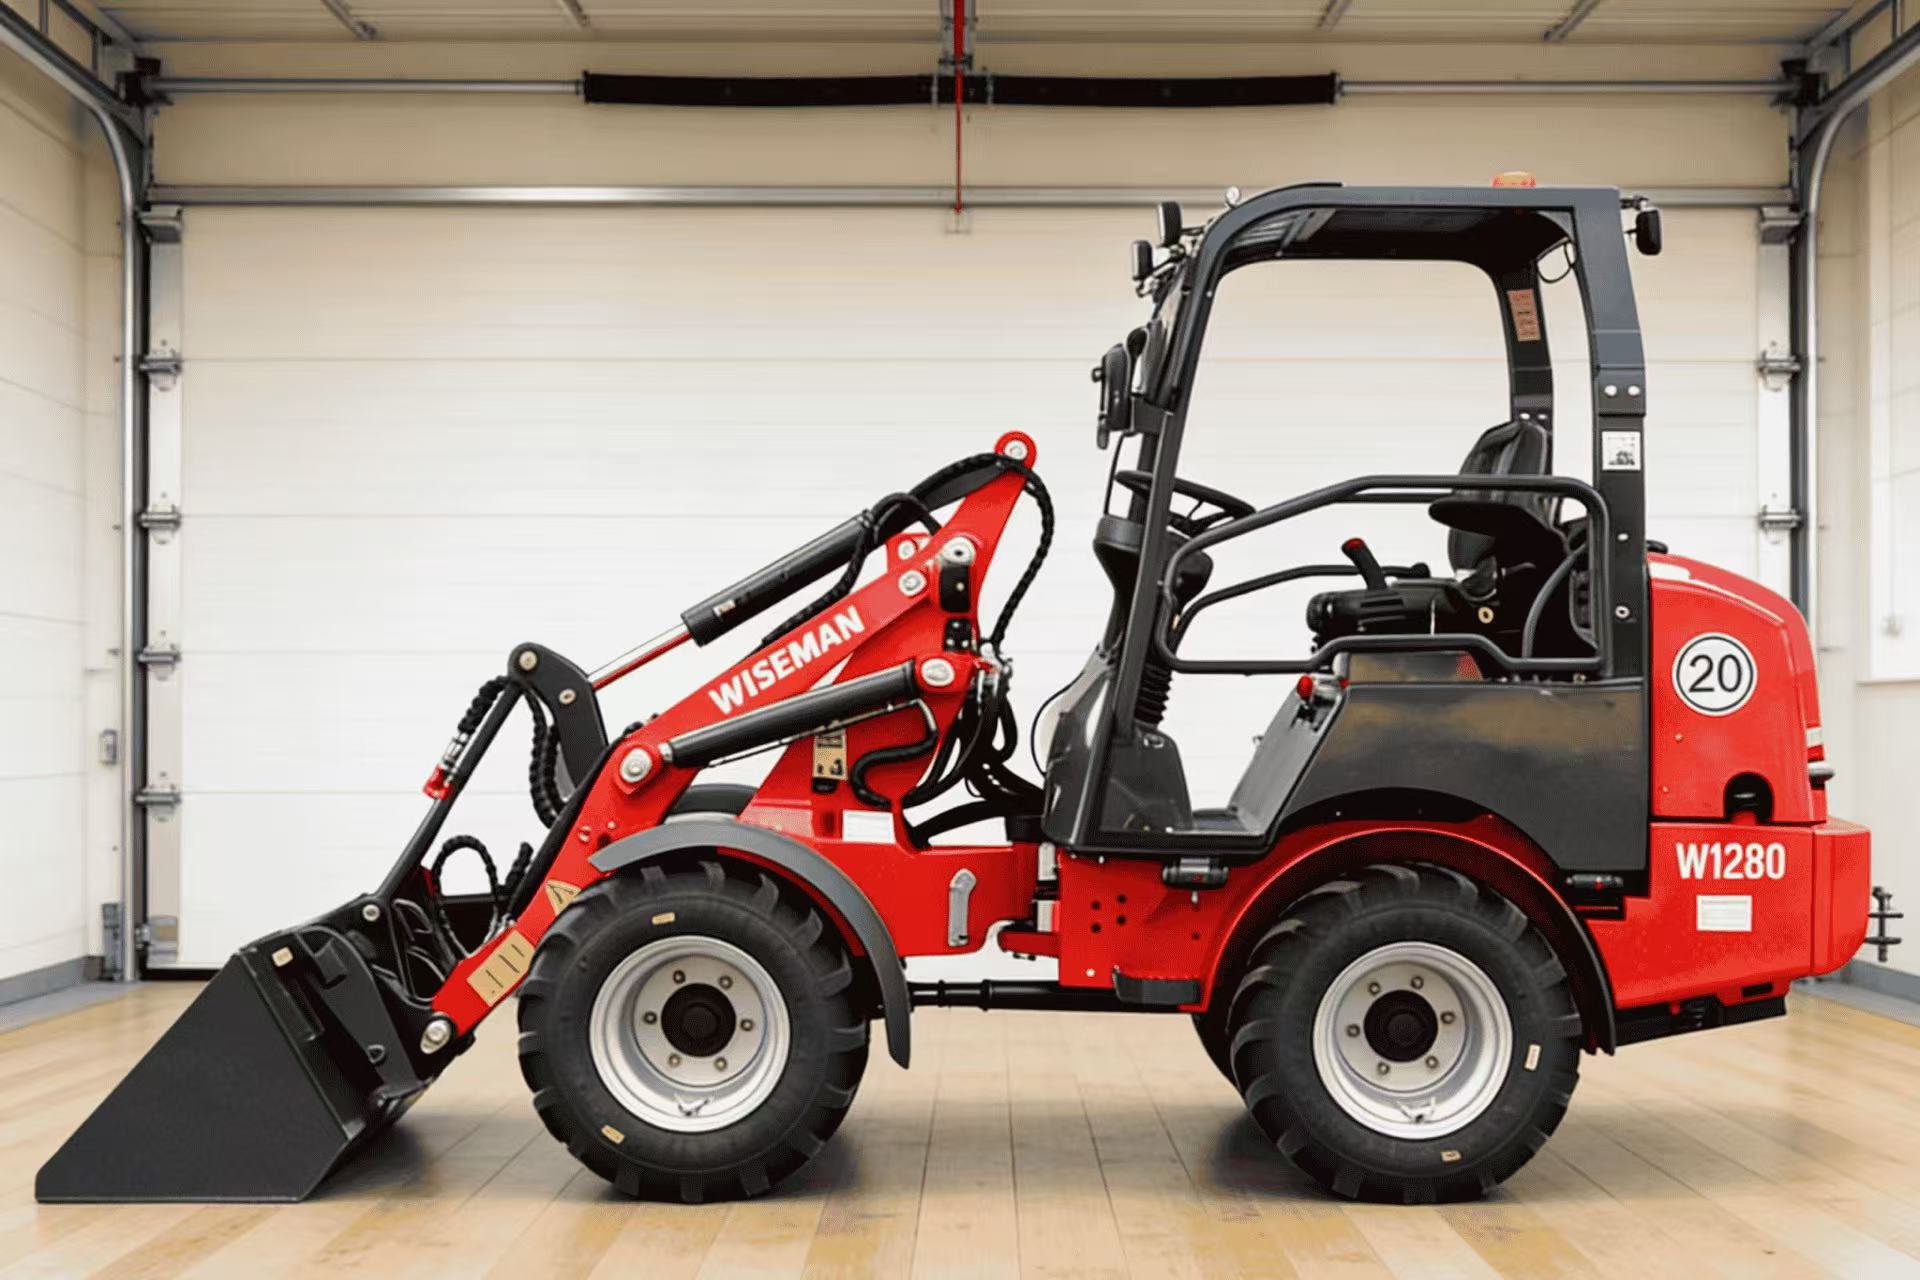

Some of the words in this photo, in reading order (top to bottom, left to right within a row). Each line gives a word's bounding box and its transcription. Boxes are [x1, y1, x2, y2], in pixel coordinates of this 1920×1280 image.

[708, 605, 865, 715] WISEMAN
[1688, 654, 1742, 693] 20
[1676, 842, 1786, 880] W1280
